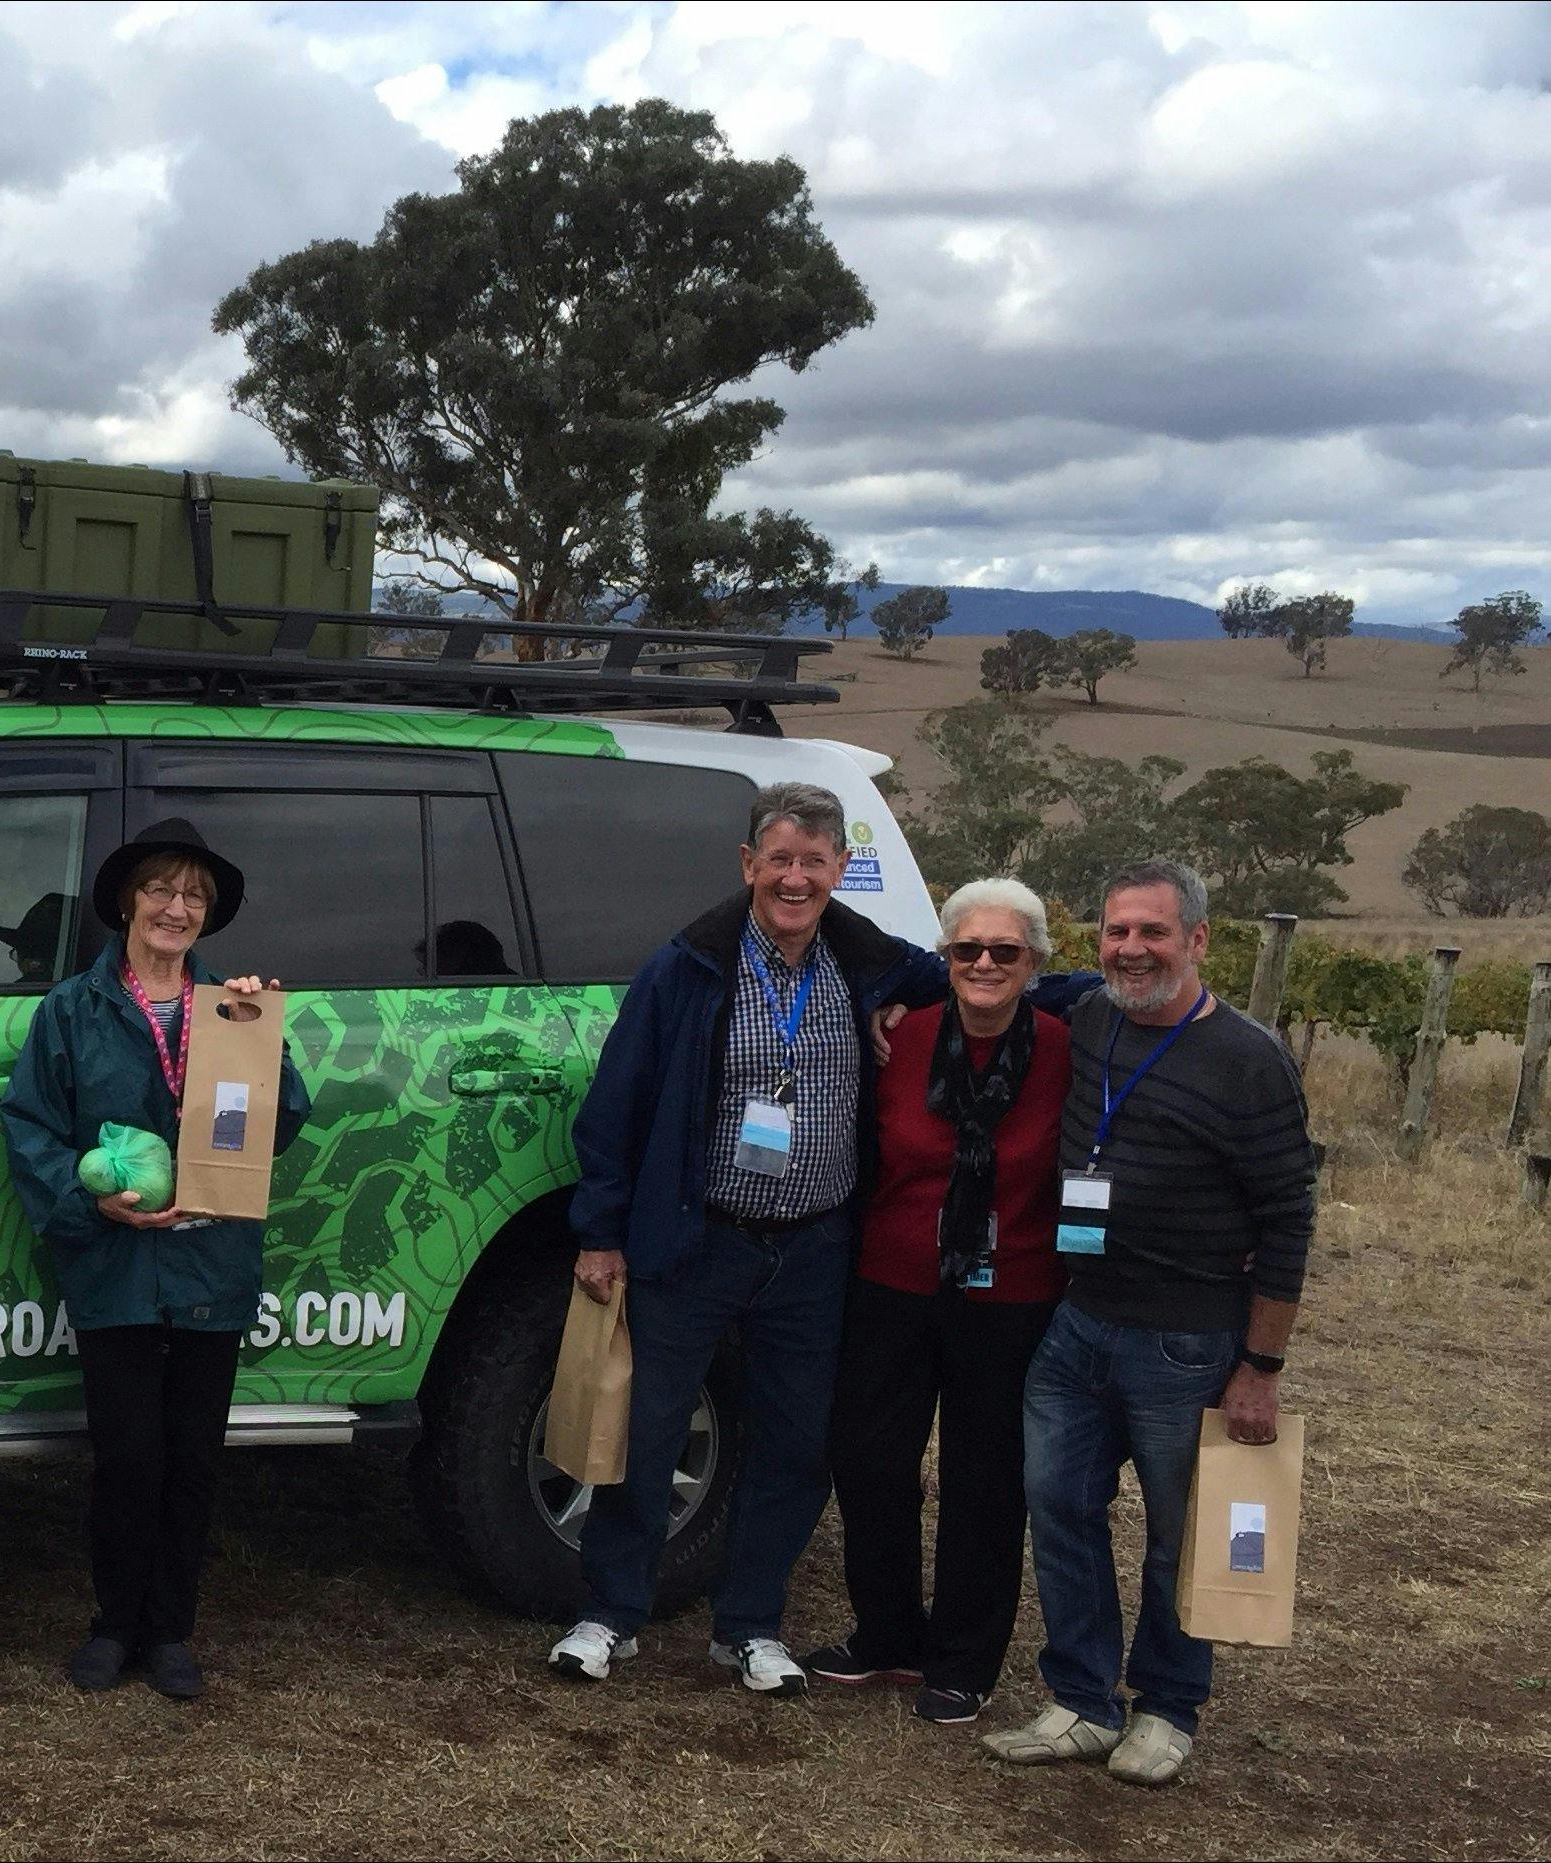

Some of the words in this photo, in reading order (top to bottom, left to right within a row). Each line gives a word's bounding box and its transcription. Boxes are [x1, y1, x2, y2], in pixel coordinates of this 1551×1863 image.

[23, 647, 88, 660] RHINO-RACK
[849, 846, 878, 858] FIED
[840, 879, 882, 890] tourism
